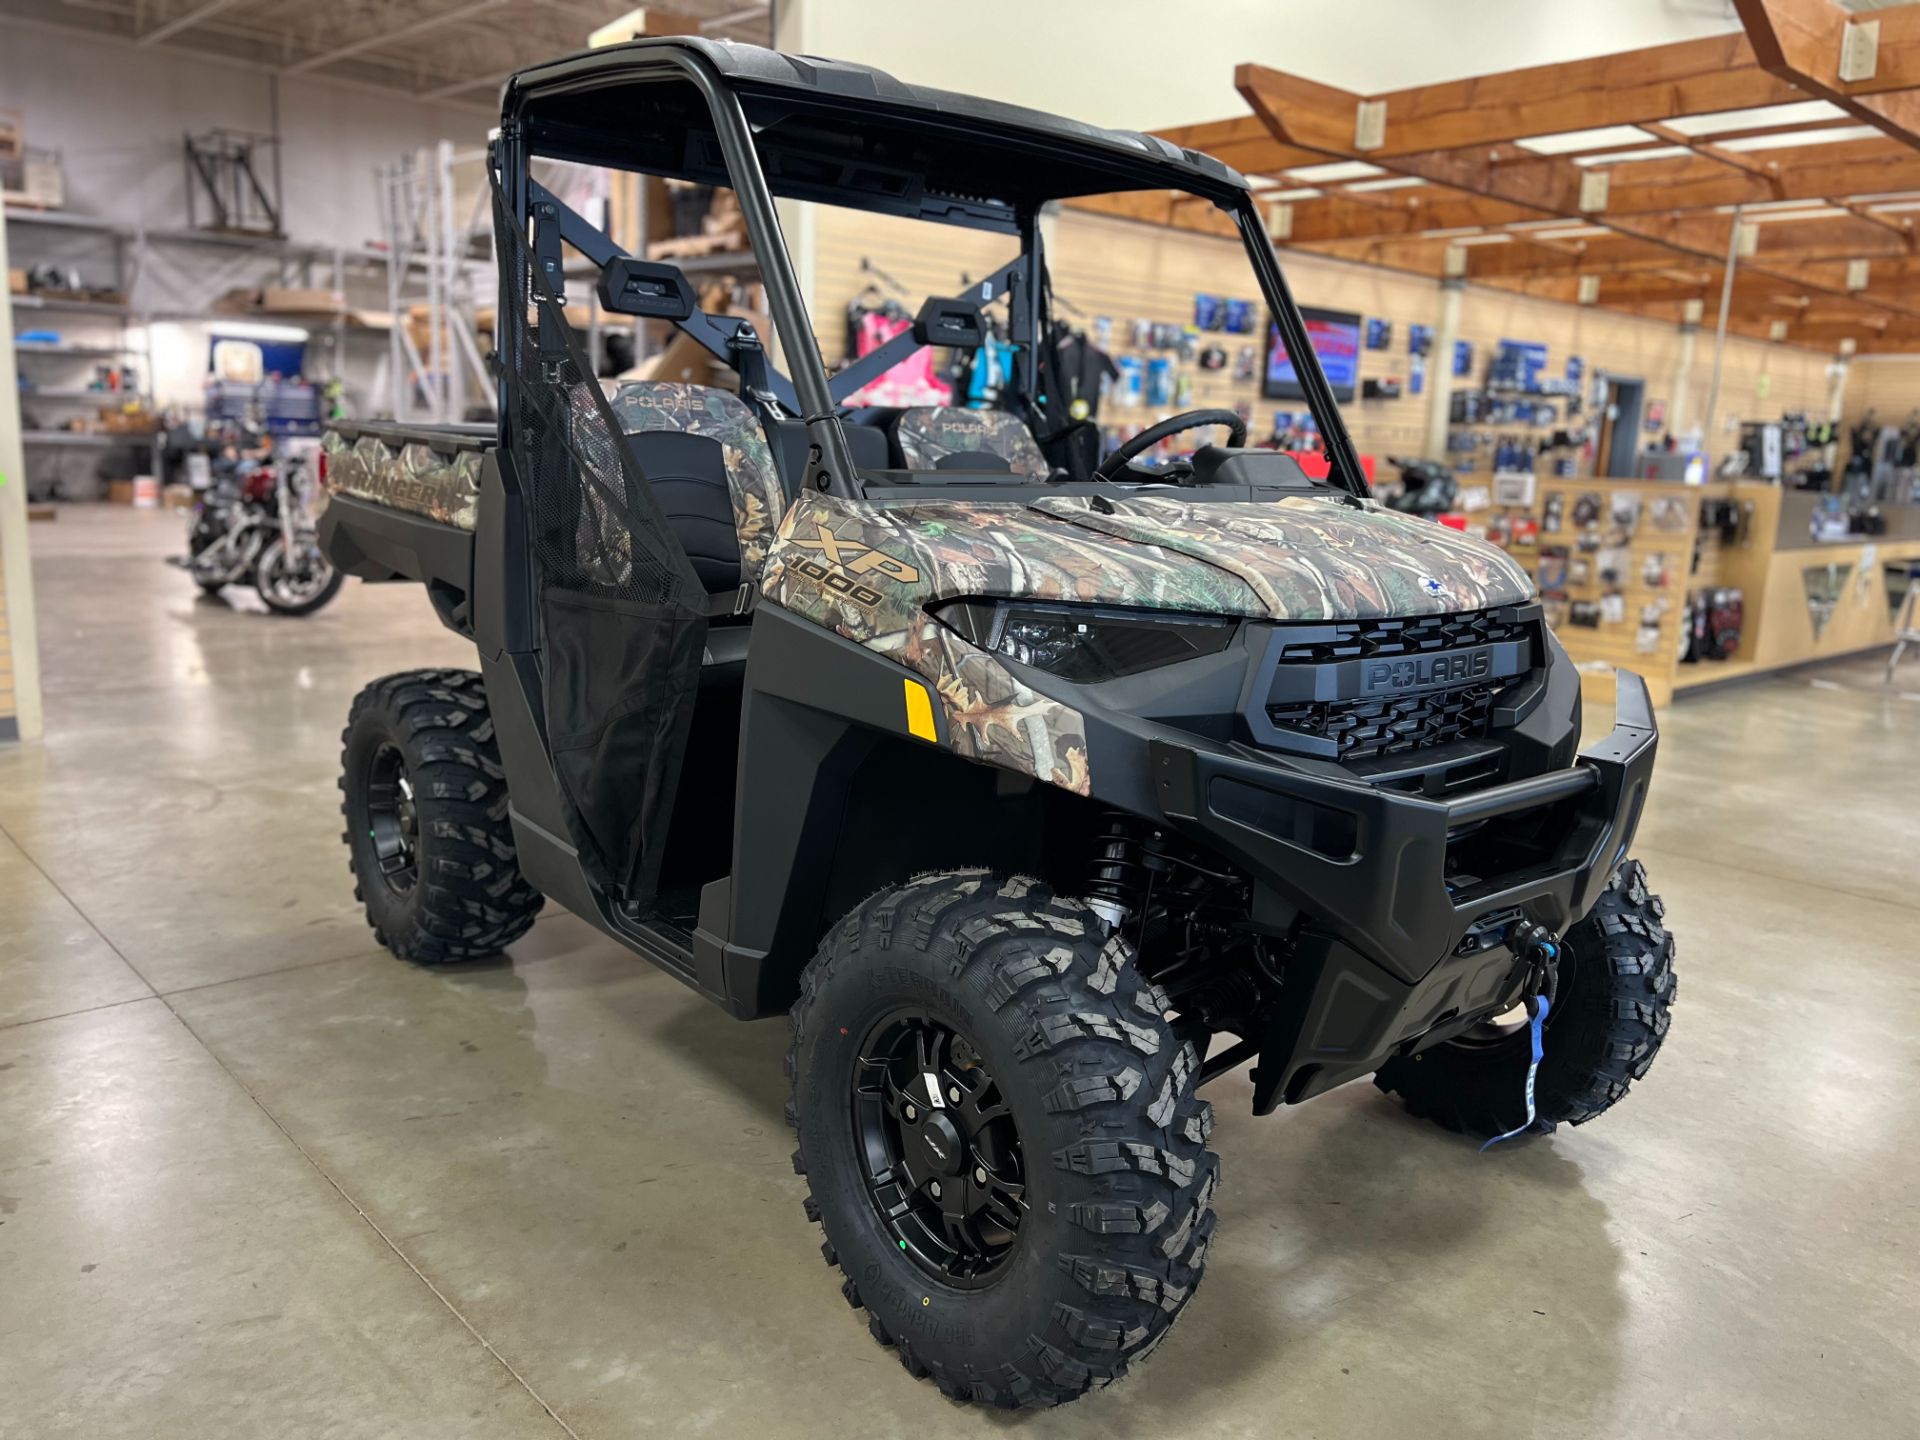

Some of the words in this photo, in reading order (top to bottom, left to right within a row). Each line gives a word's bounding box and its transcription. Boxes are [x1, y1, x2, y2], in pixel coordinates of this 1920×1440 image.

[624, 396, 704, 411] POLARIS
[354, 467, 438, 503] RANGER
[784, 523, 920, 584] XP
[787, 554, 885, 608] 1000
[1367, 651, 1489, 691] POLARIS
